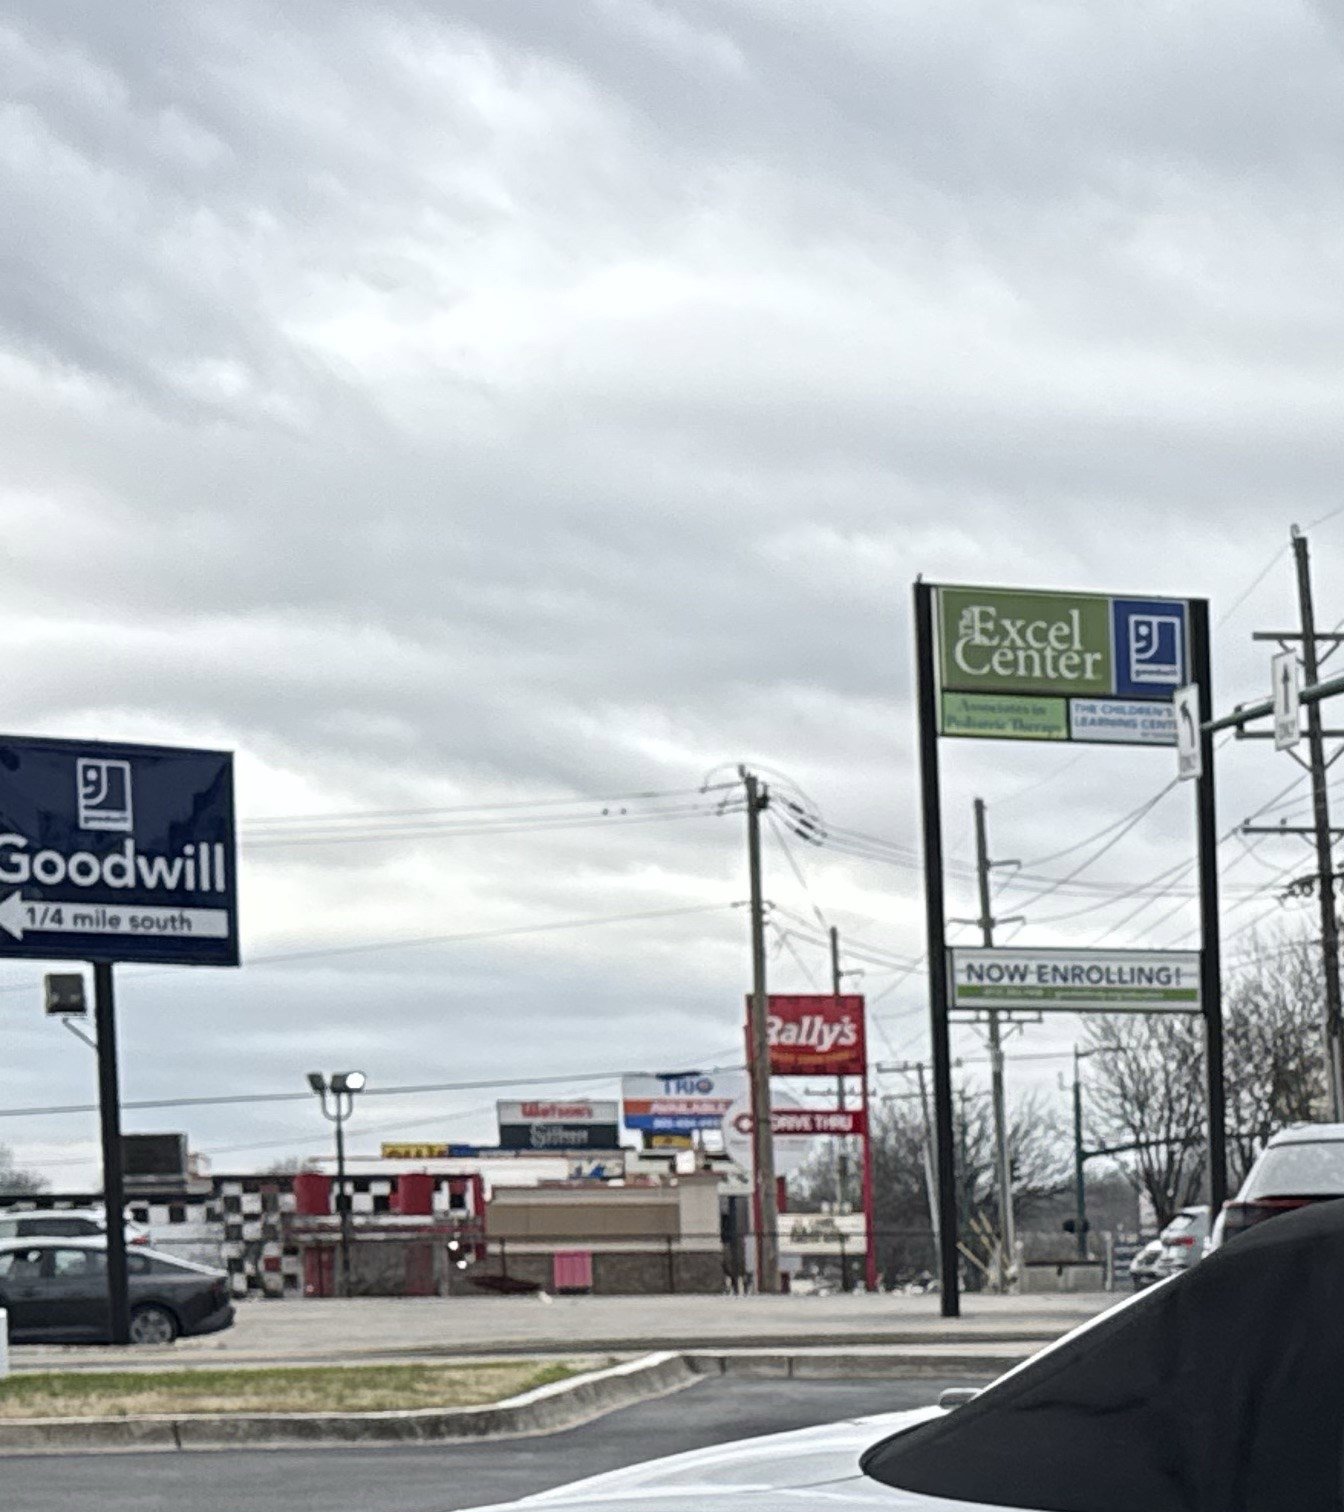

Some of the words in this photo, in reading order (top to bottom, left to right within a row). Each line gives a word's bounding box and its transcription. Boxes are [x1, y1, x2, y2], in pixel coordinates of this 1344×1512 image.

[971, 605, 1082, 650] Excel
[955, 634, 1102, 680] Center
[0, 833, 225, 892] Goodwill
[26, 906, 64, 927] 1/4
[72, 908, 121, 930] mile
[129, 911, 193, 932] south
[966, 963, 1029, 982] NOW
[1037, 964, 1181, 985] ENROLLING!
